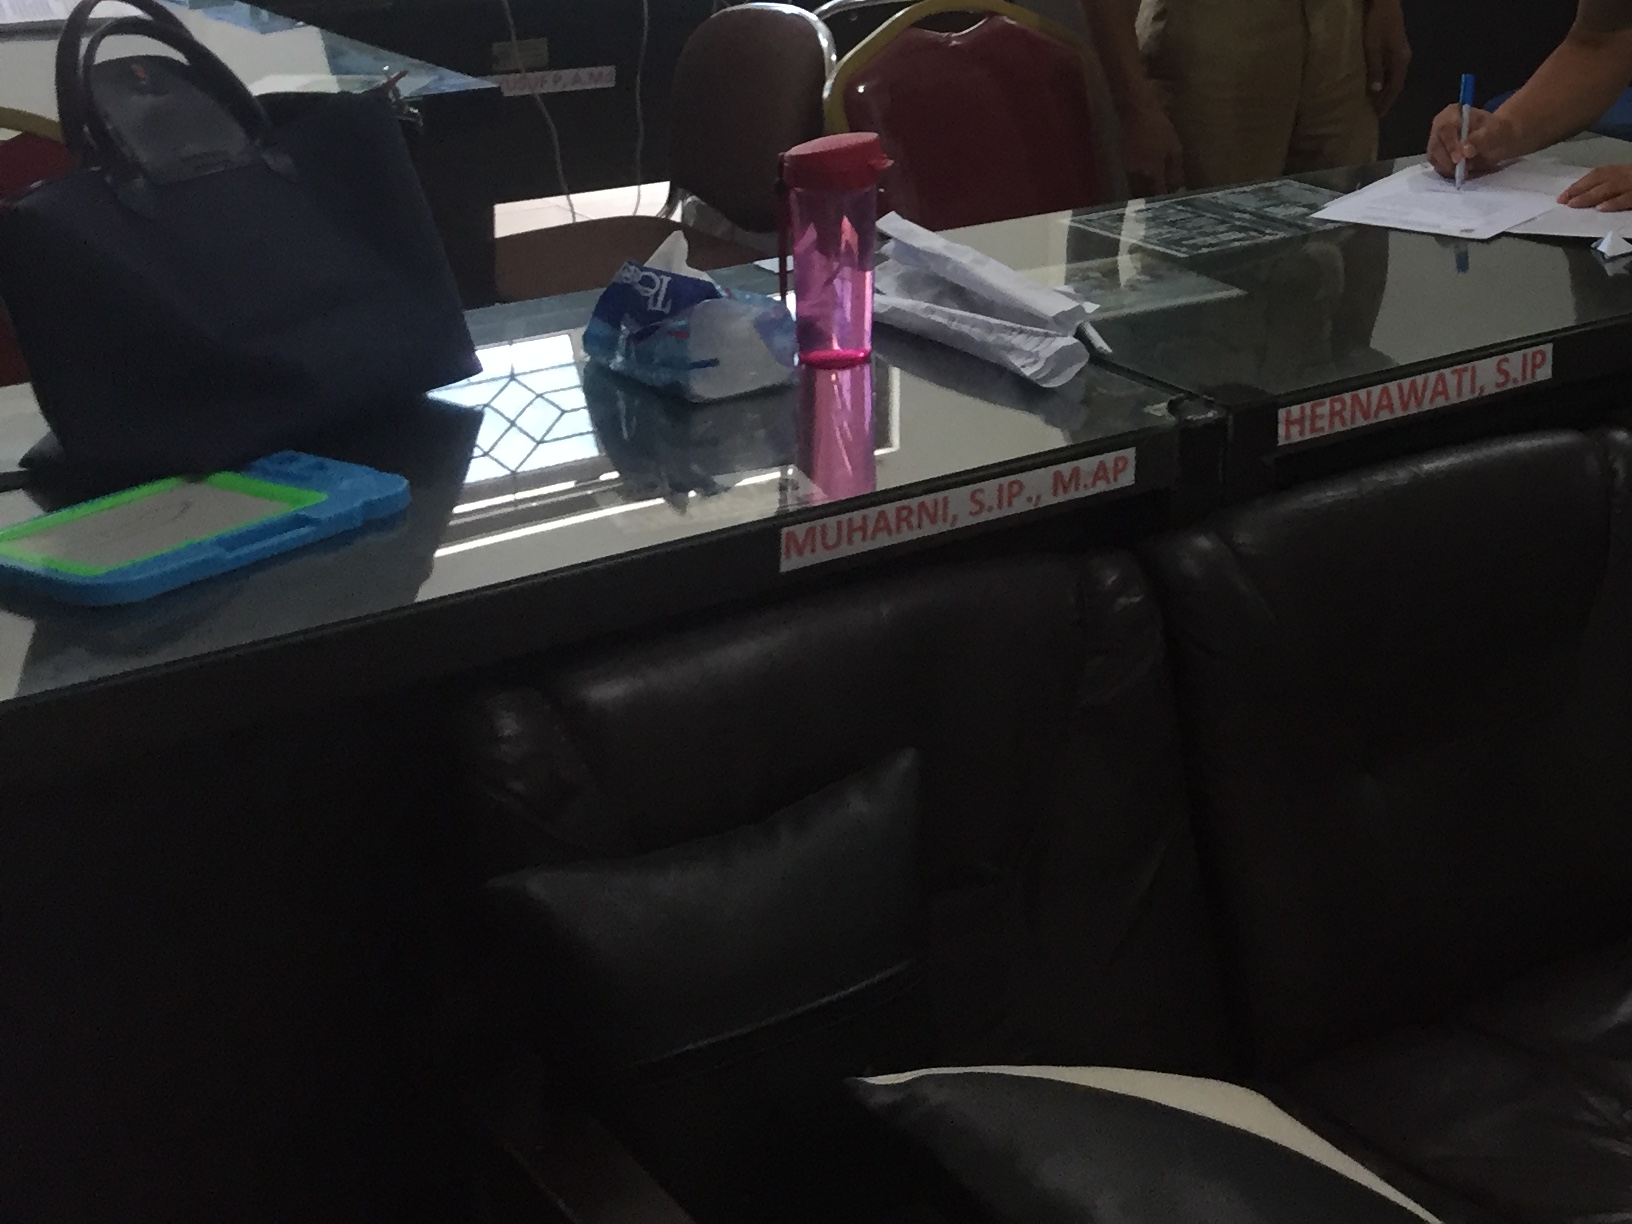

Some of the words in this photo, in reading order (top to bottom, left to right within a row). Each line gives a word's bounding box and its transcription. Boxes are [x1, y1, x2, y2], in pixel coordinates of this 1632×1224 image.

[1283, 365, 1486, 442] HERNAWATI,
[1495, 349, 1547, 390] S.IP
[783, 494, 959, 560] MUHARNI,
[968, 478, 1042, 518] S.IP.,
[1052, 454, 1129, 498] M.AP
